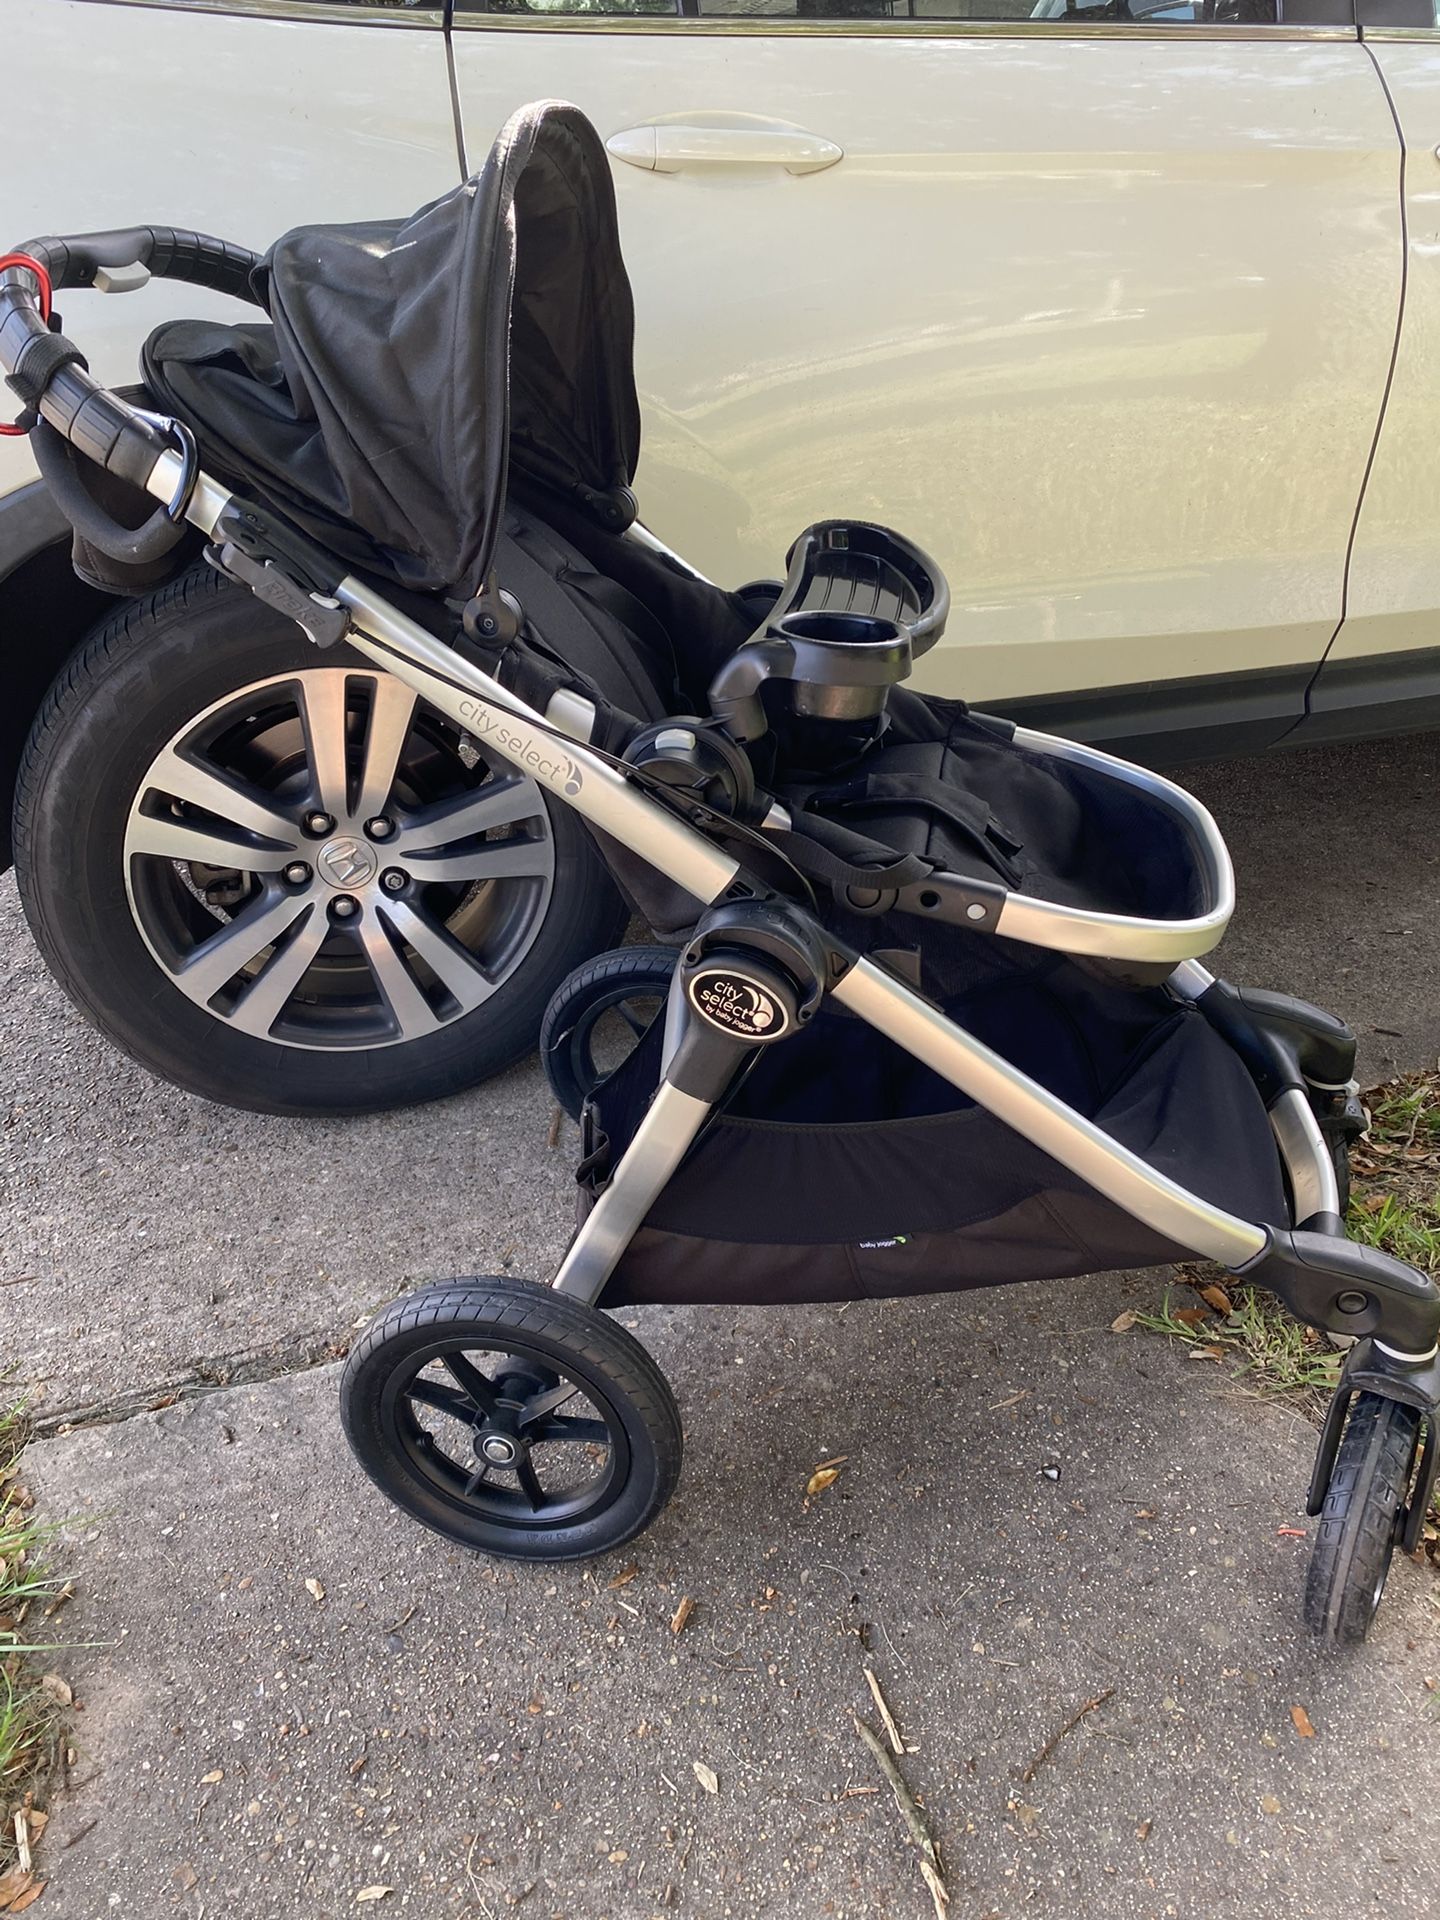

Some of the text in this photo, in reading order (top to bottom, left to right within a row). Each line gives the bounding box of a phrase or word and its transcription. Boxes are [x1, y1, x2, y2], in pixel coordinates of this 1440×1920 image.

[458, 700, 561, 781] city select
[714, 981, 743, 1002] city
[700, 990, 749, 1020] select
[705, 1003, 715, 1014] by
[715, 1009, 733, 1022] baby
